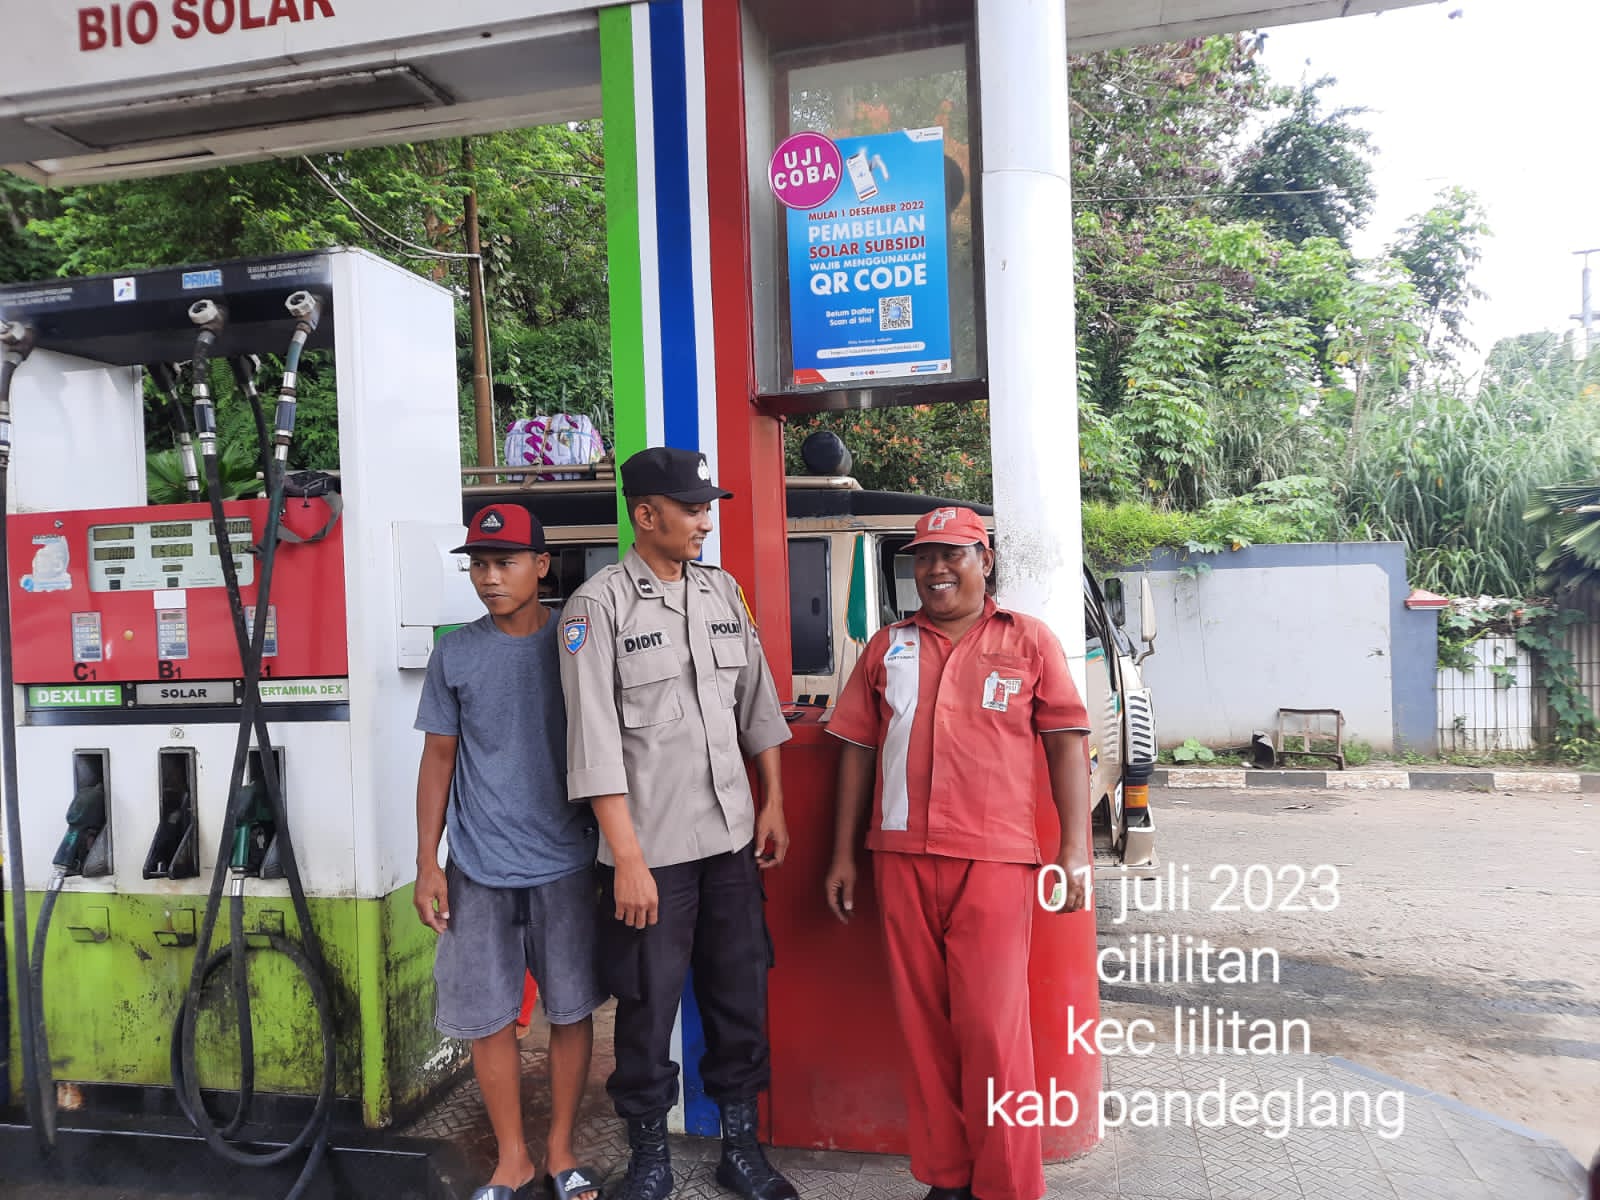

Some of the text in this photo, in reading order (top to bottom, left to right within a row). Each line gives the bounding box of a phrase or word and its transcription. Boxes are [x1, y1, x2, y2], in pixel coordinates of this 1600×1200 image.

[78, 0, 158, 52] BIO
[783, 146, 822, 169] UJI
[774, 163, 837, 190] COBA
[808, 210, 838, 221] MULAI
[849, 204, 897, 217] DESEMBER
[899, 200, 925, 211] 2022
[808, 214, 926, 243] PEMBELIAN
[809, 235, 926, 259] SOLAR SUBSIDI
[810, 252, 926, 272] WAJIB MENGGUNAKAN
[183, 271, 221, 286] PRIME
[809, 263, 928, 296] QR CODE
[623, 631, 663, 653] DIDIT
[73, 662, 97, 682] C1
[158, 659, 182, 680] B1
[37, 688, 116, 703] DEXLITE
[160, 687, 207, 699] SOLAR
[261, 684, 344, 697] ERTAMINA DEX
